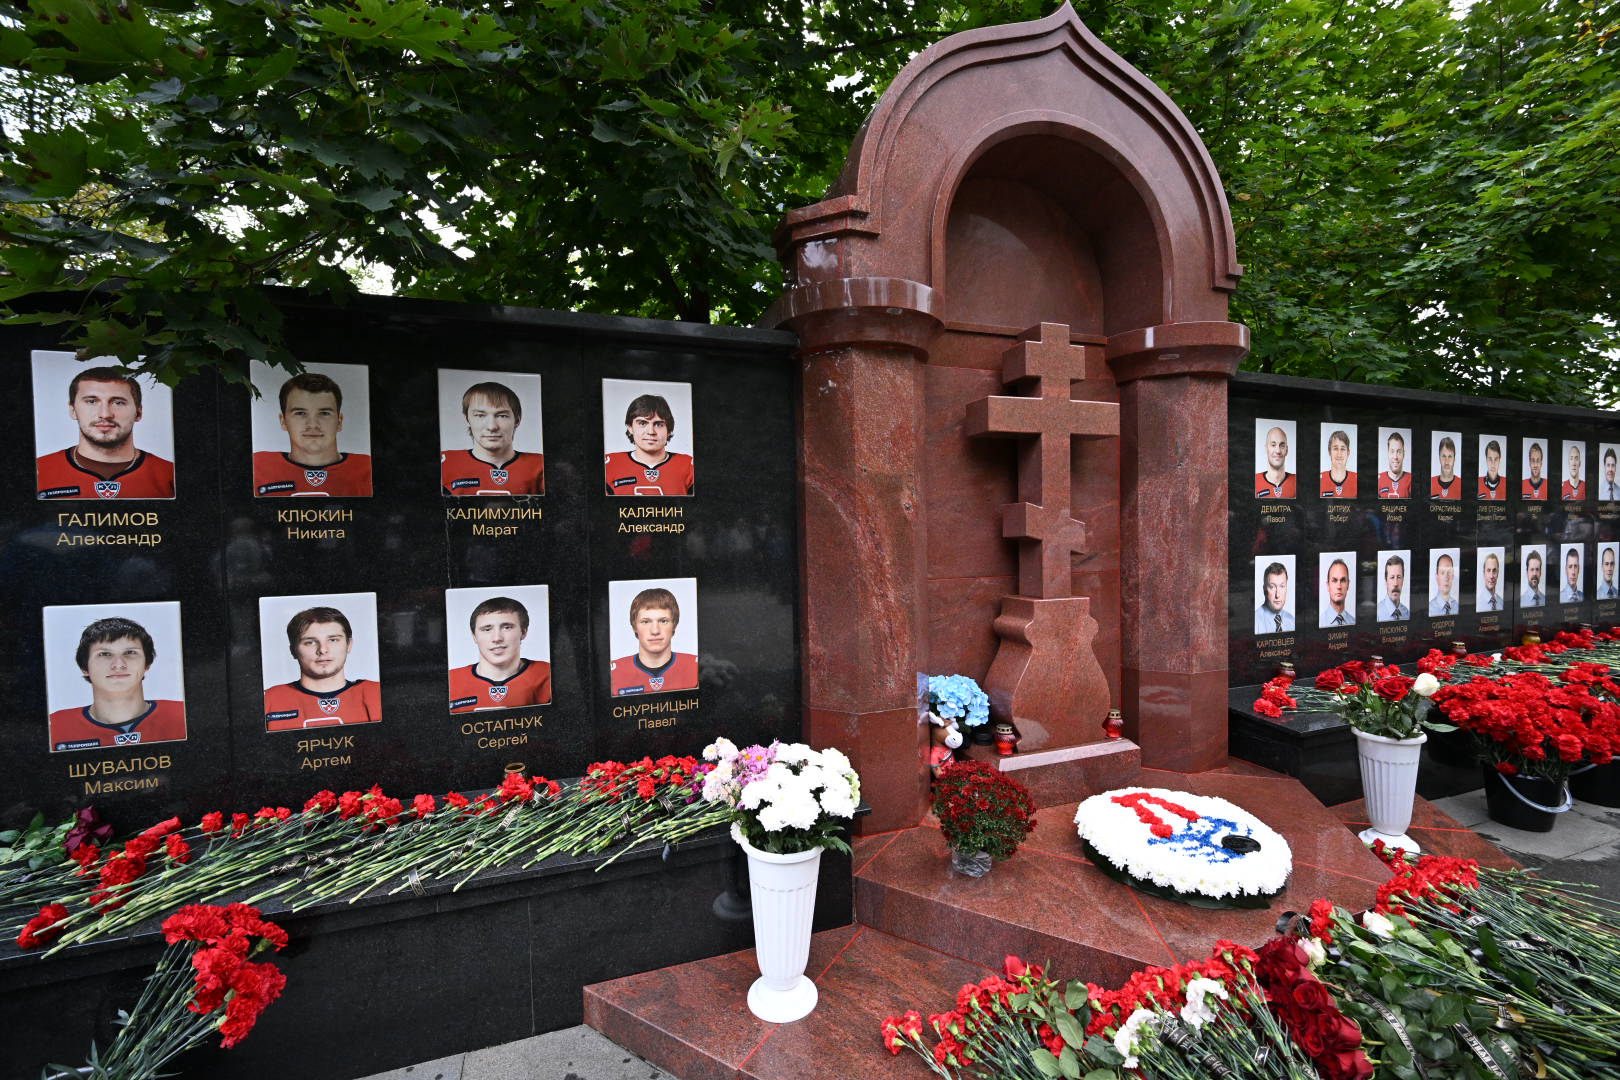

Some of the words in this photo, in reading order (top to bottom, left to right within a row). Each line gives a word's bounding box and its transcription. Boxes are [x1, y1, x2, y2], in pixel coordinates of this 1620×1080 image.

[278, 509, 353, 523] КЛЮКИН
[447, 508, 542, 520] КАЛИМУЛИН
[619, 507, 683, 518] КАЛЯНИН
[1261, 505, 1292, 513] ДЕМИТРА
[58, 513, 159, 527] ГАЛИМОВ
[287, 526, 345, 539] Никита
[472, 524, 518, 536] Марат
[618, 522, 685, 534] Александр
[57, 532, 162, 547] Александр
[1256, 638, 1295, 648] КАРПОВЦЕВ
[613, 699, 699, 718] СНУРНИЦЫН
[461, 716, 543, 734] ОСТАПЧУК
[638, 716, 676, 729] Павел
[297, 735, 354, 753] ЯРЧУК
[478, 734, 528, 750] Сергей
[68, 755, 172, 778] ШУВАЛОВ
[301, 754, 351, 770] Артем
[85, 775, 159, 795] Максим
